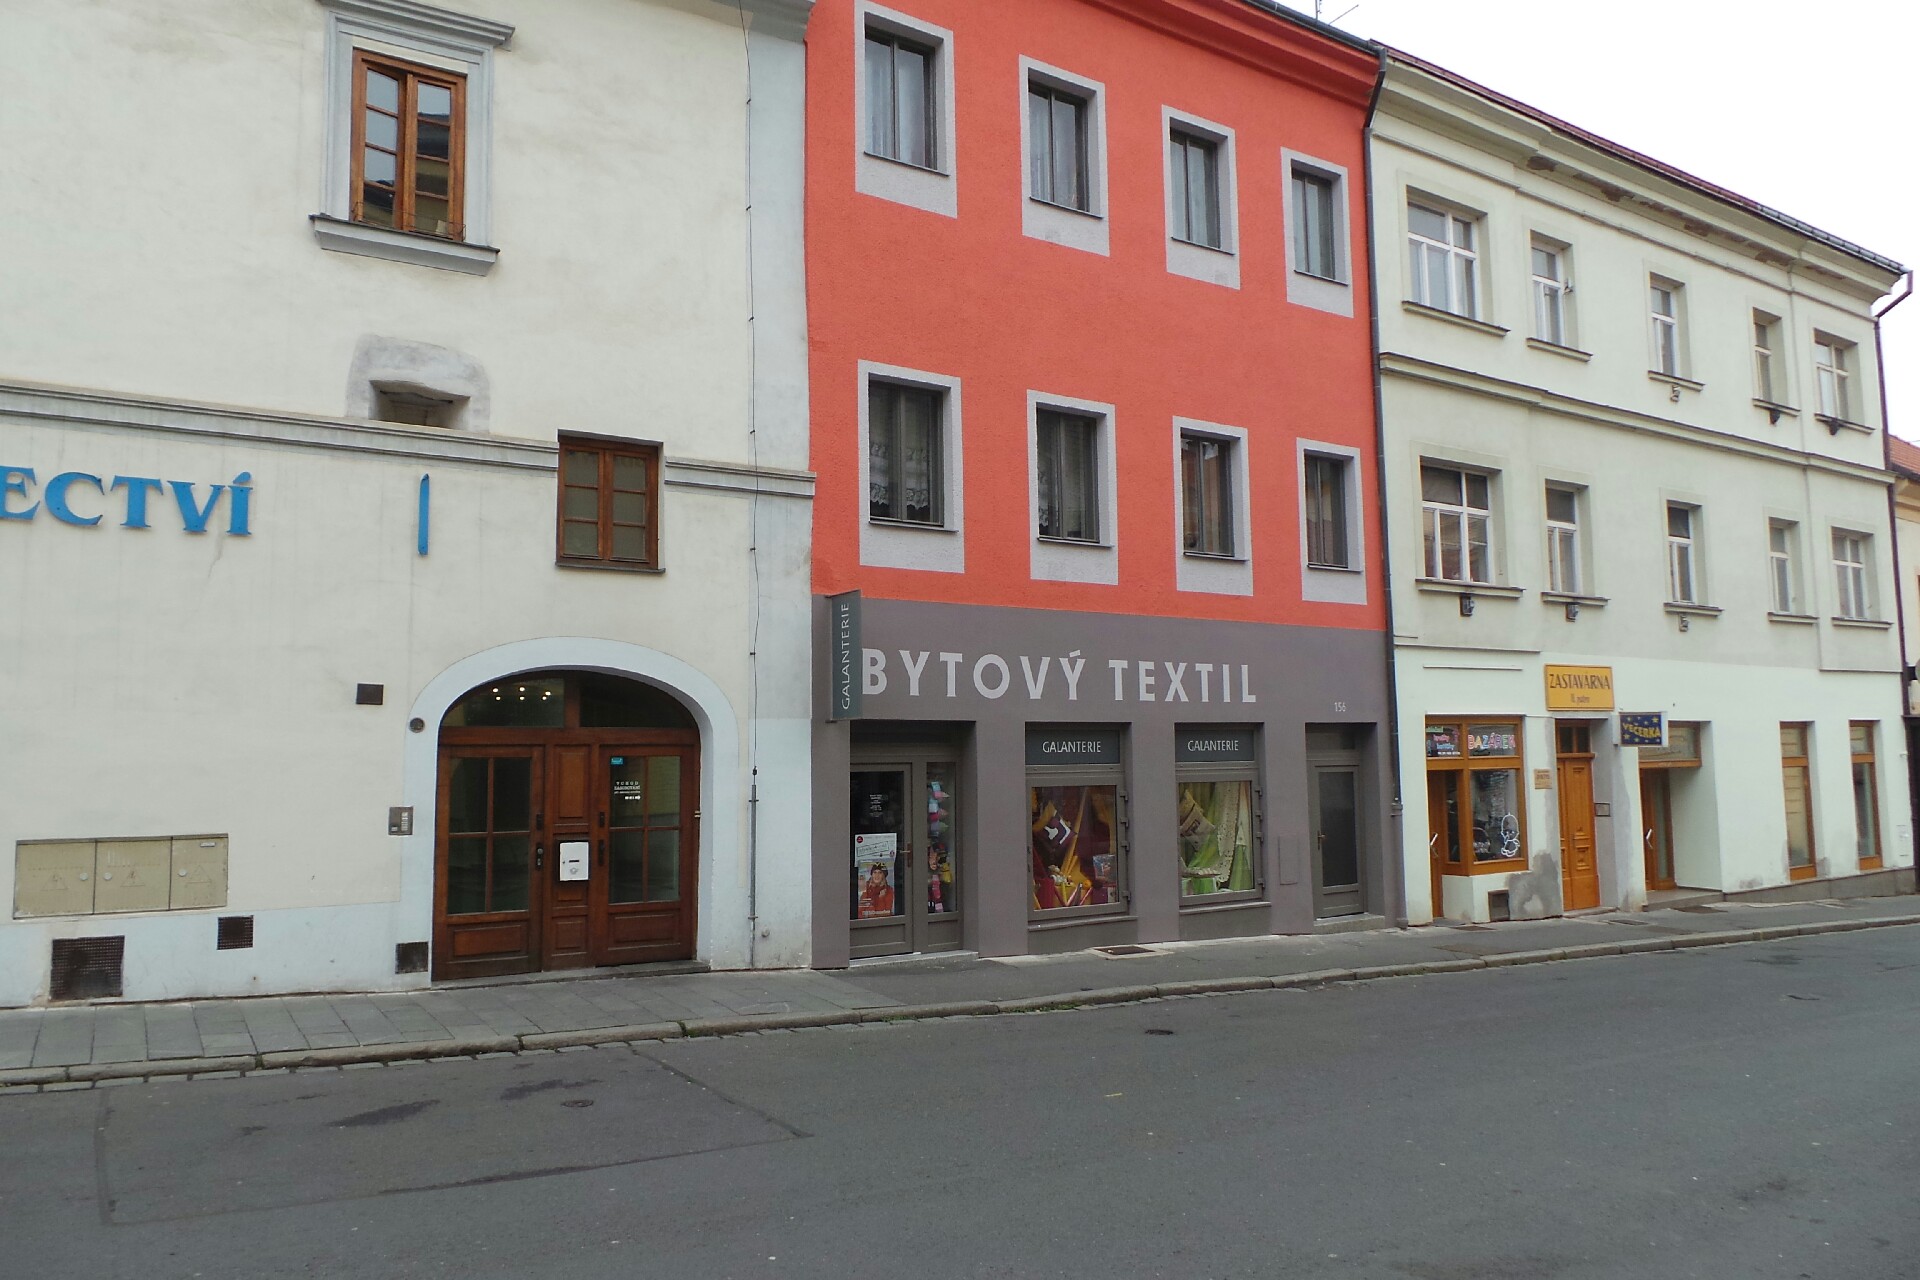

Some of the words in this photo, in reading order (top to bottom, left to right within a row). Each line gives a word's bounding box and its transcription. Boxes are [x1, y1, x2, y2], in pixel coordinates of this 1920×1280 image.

[841, 602, 850, 710] GALANTERIE
[862, 647, 1087, 701] BYTOVÝ
[1108, 659, 1257, 703] TEXTIL
[1549, 672, 1611, 690] ZASTAVÁRNA
[1334, 702, 1347, 712] 156
[1622, 722, 1661, 738] VEČERKA
[1042, 740, 1102, 753] GALANTERIE
[1187, 740, 1239, 752] GALANTERIE
[1467, 732, 1516, 750] BAZÁREK
